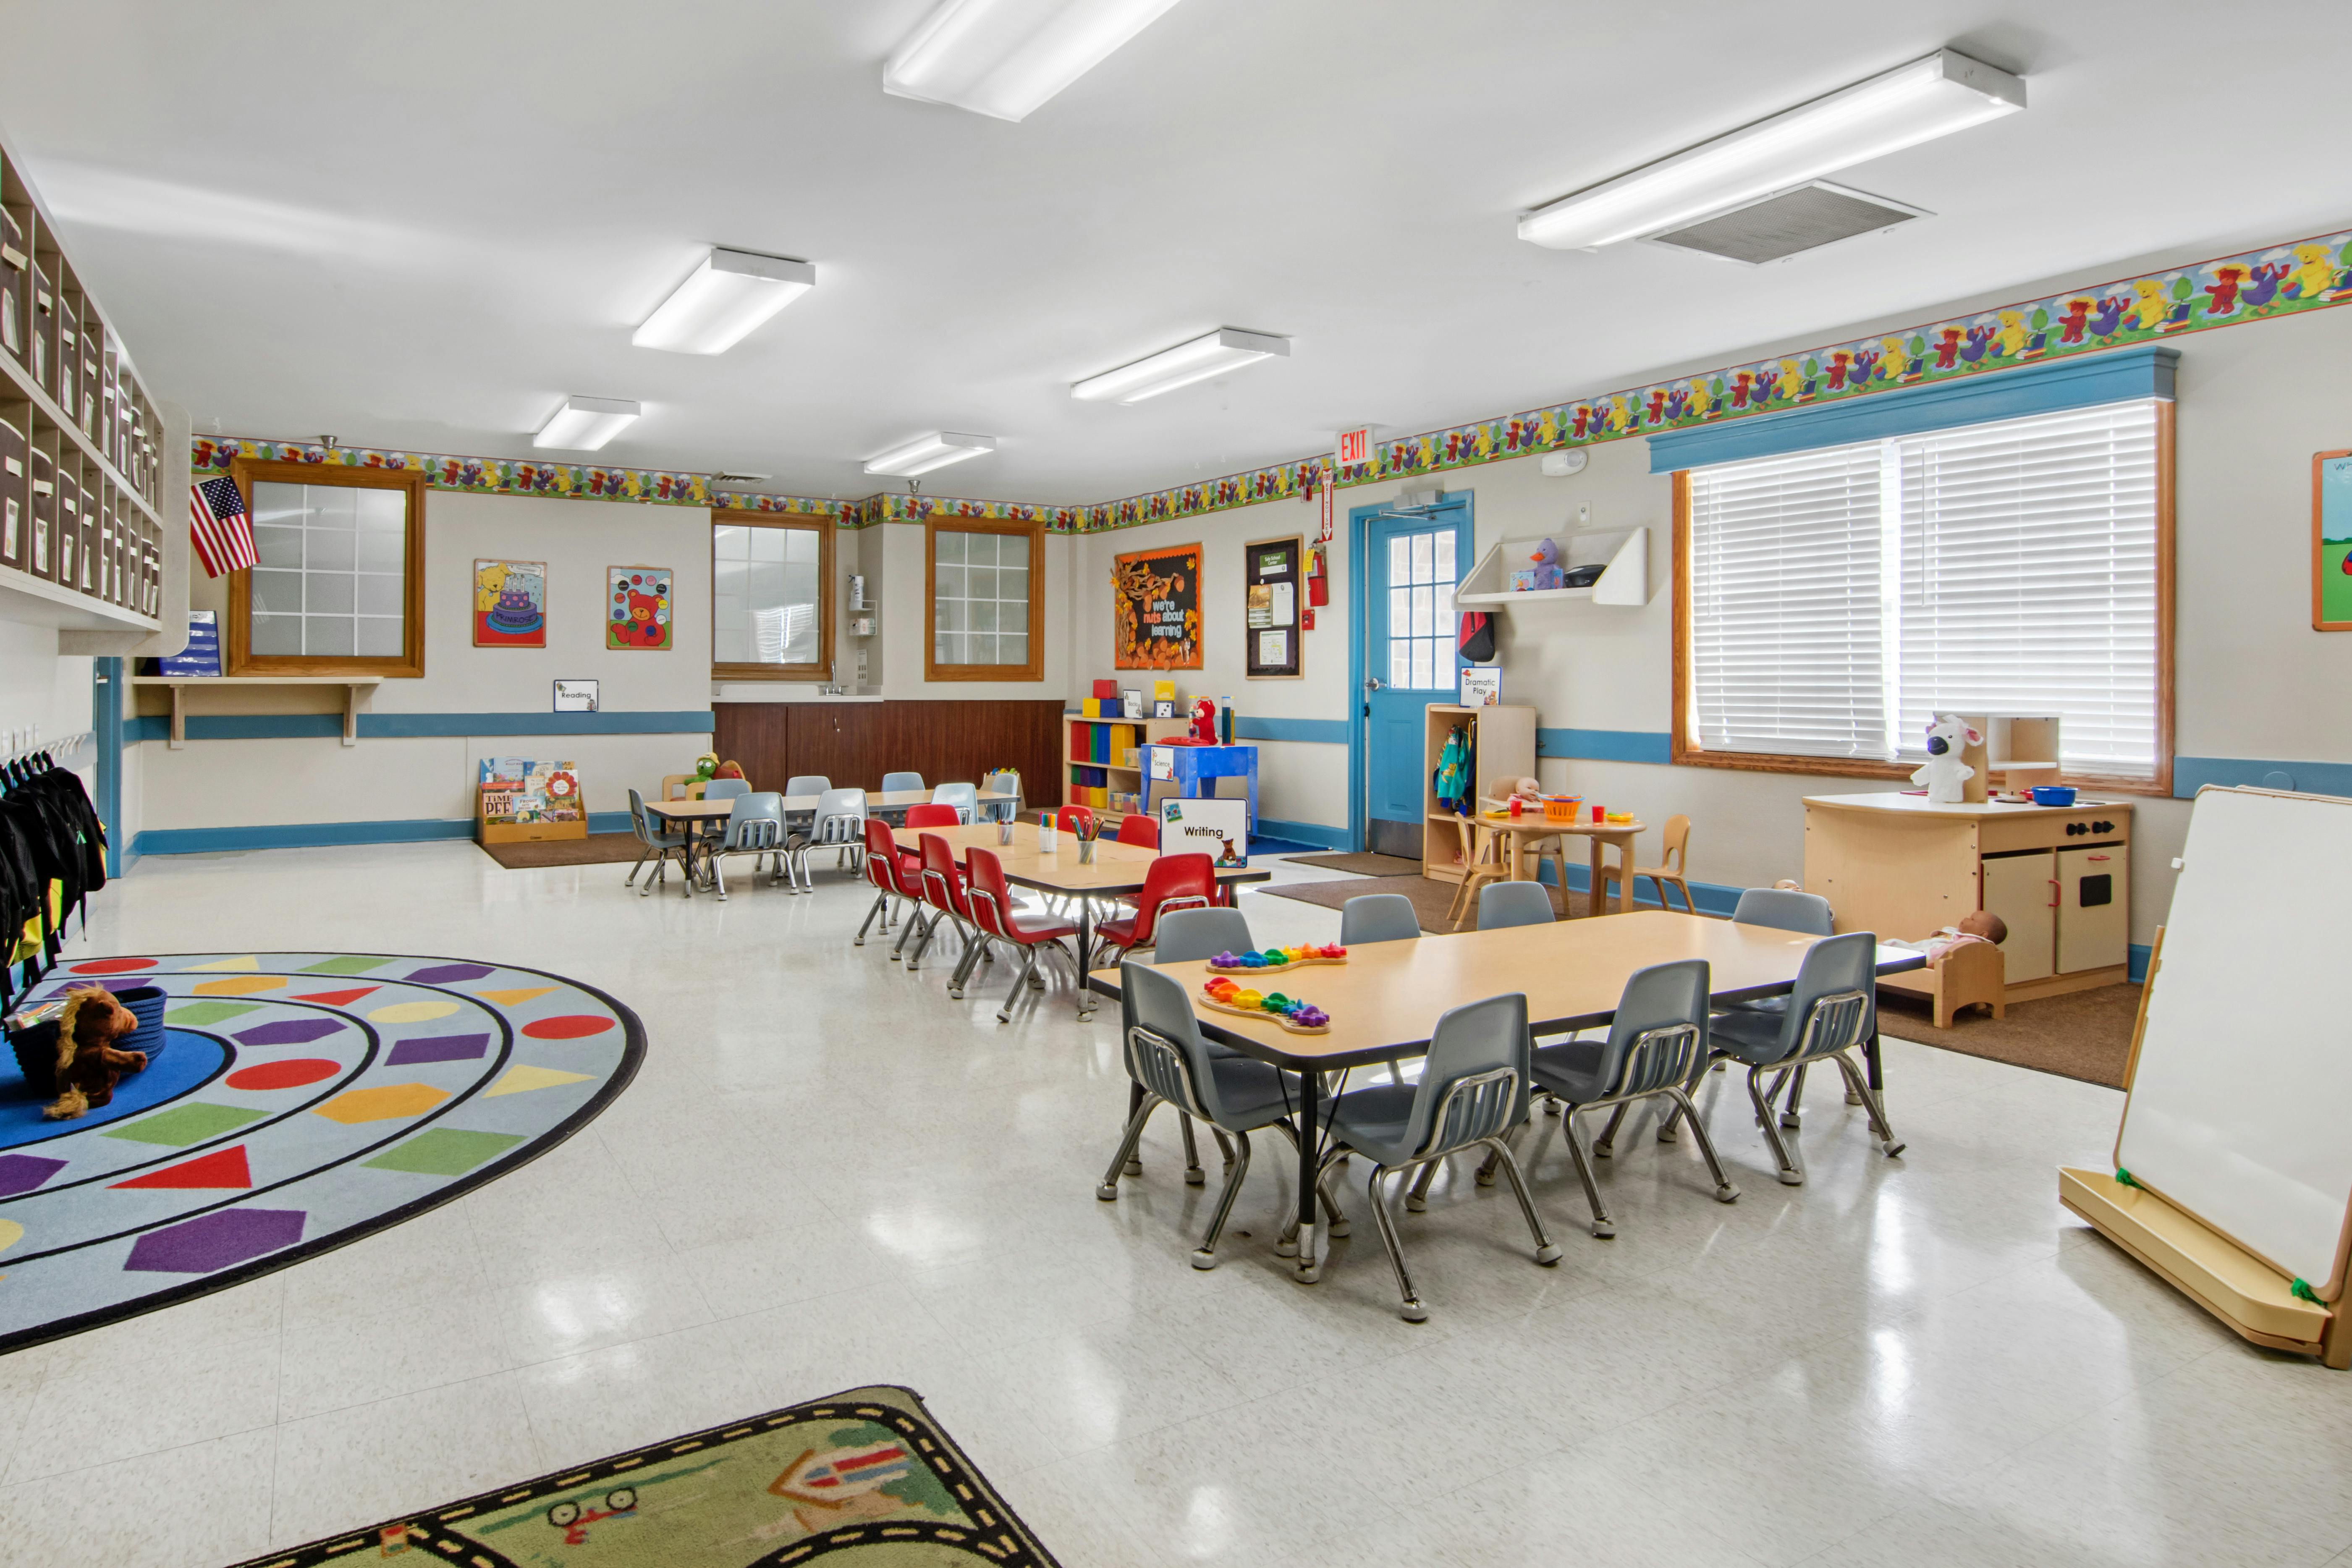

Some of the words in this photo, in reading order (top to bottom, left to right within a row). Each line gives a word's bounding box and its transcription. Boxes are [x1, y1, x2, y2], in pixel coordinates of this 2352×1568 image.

[1341, 429, 1367, 462] EXIT
[1152, 599, 1175, 611] we're
[496, 612, 534, 623] PRIMROSE
[1143, 611, 1161, 624] nuts
[1162, 609, 1184, 622] about
[1151, 624, 1182, 638] learning
[1184, 826, 1223, 839] Writing
